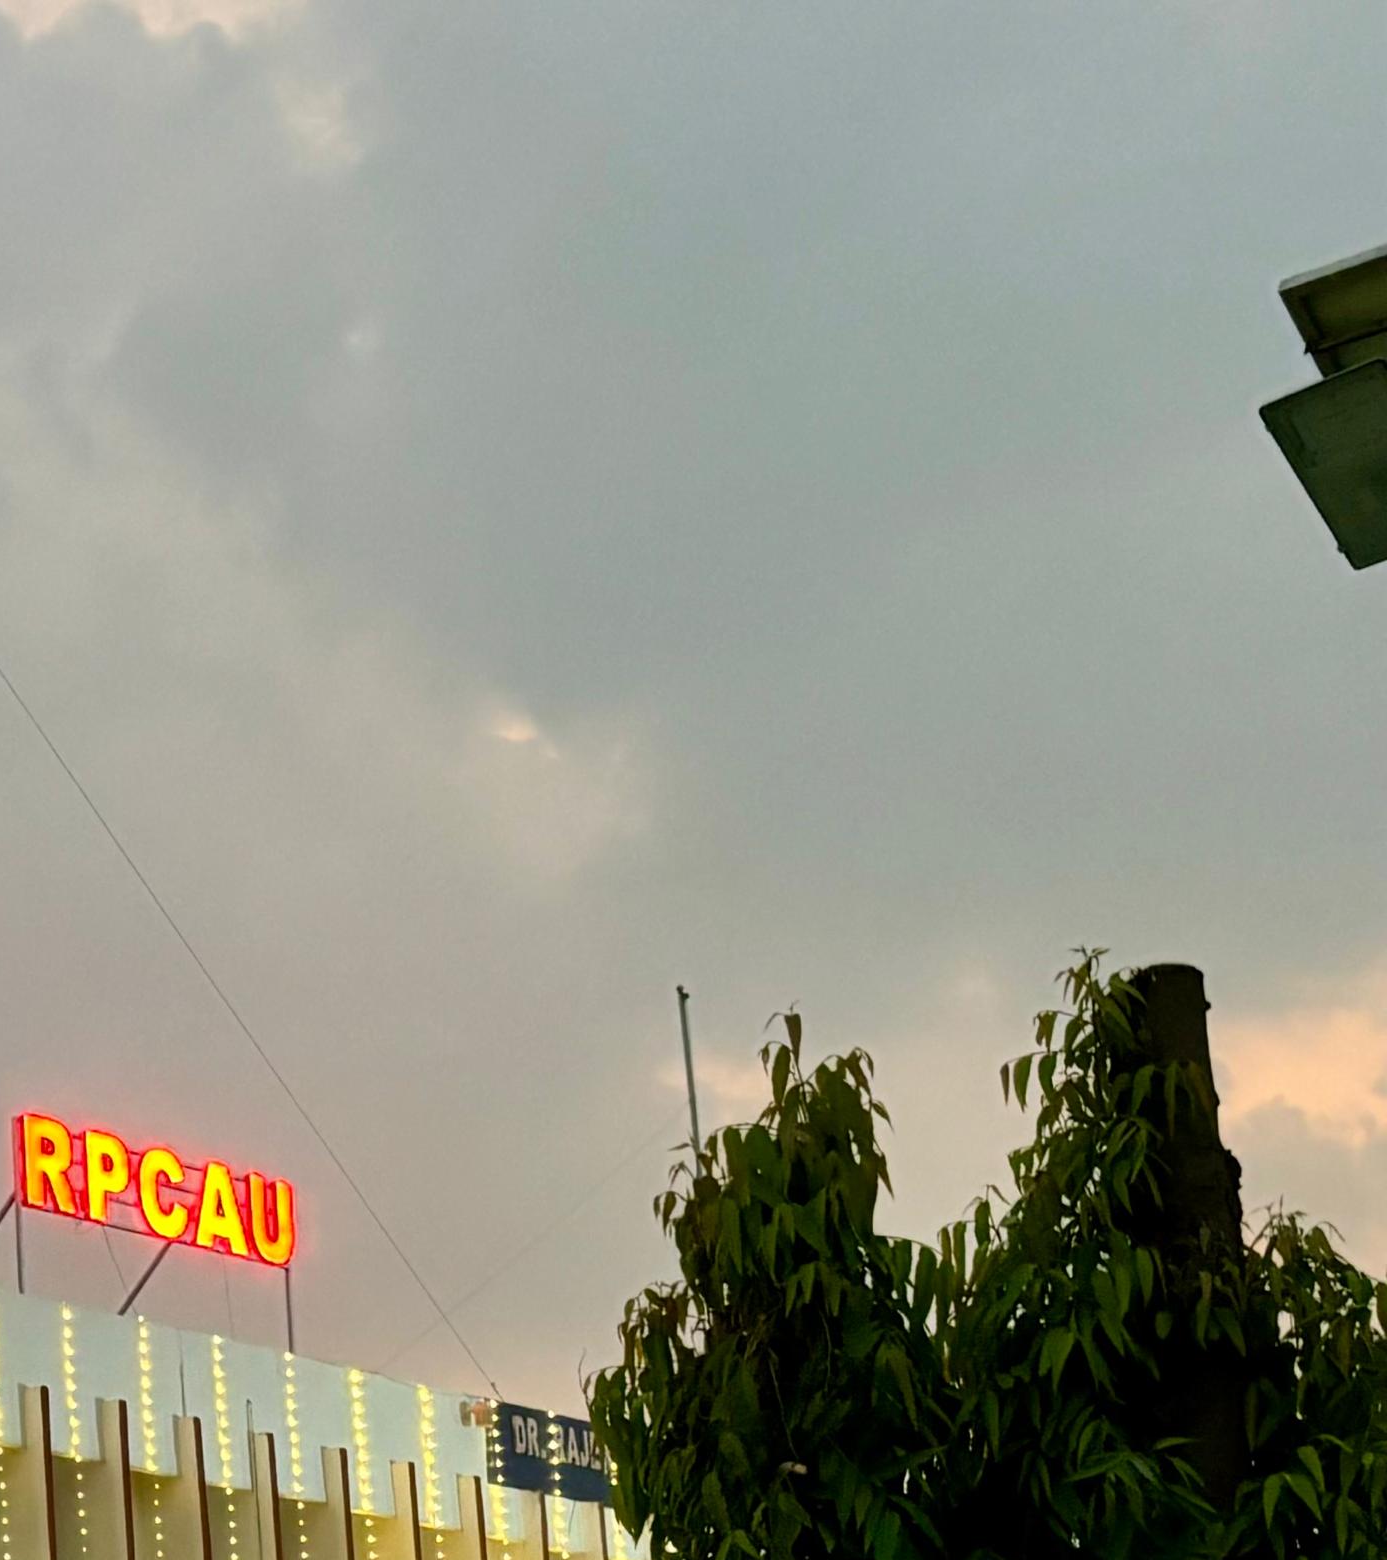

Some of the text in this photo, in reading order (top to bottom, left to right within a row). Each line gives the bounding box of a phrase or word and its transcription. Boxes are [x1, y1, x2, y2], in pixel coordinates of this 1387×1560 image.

[18, 1113, 296, 1267] RPCAU
[512, 1414, 615, 1475] DR. RAJEN
